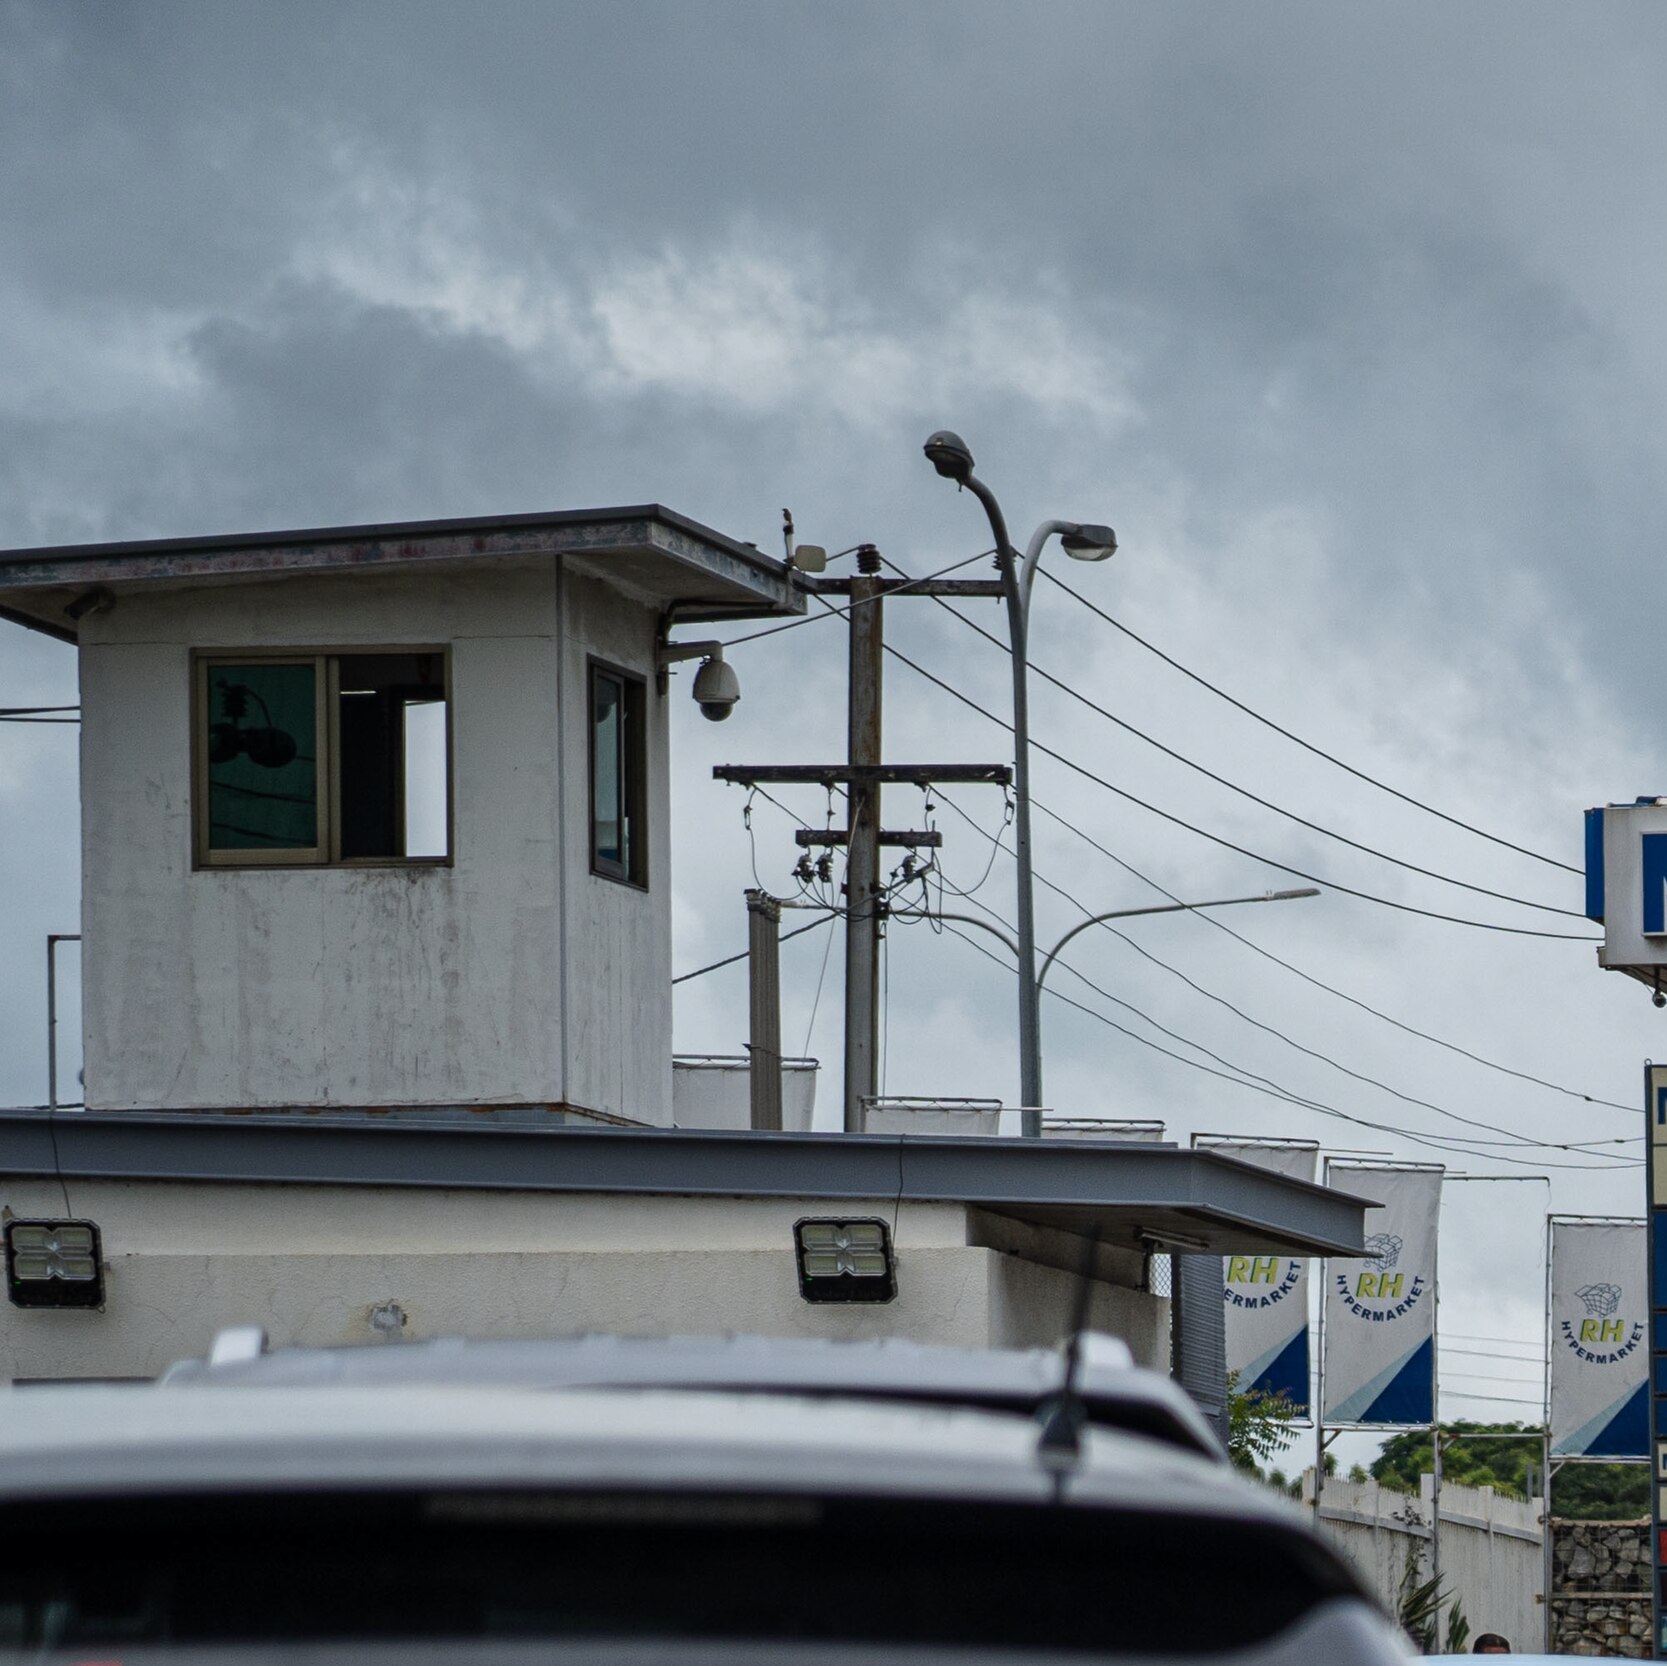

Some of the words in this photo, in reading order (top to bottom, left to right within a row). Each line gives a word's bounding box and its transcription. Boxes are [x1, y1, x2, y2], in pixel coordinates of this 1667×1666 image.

[1224, 1261, 1302, 1308] ERMARKET
[1227, 1256, 1280, 1284] RH
[1356, 1272, 1404, 1298] RH
[1336, 1274, 1425, 1322] HYPERMARKET
[1561, 1321, 1645, 1364] HYPERMARKET
[1580, 1319, 1625, 1342] RH
